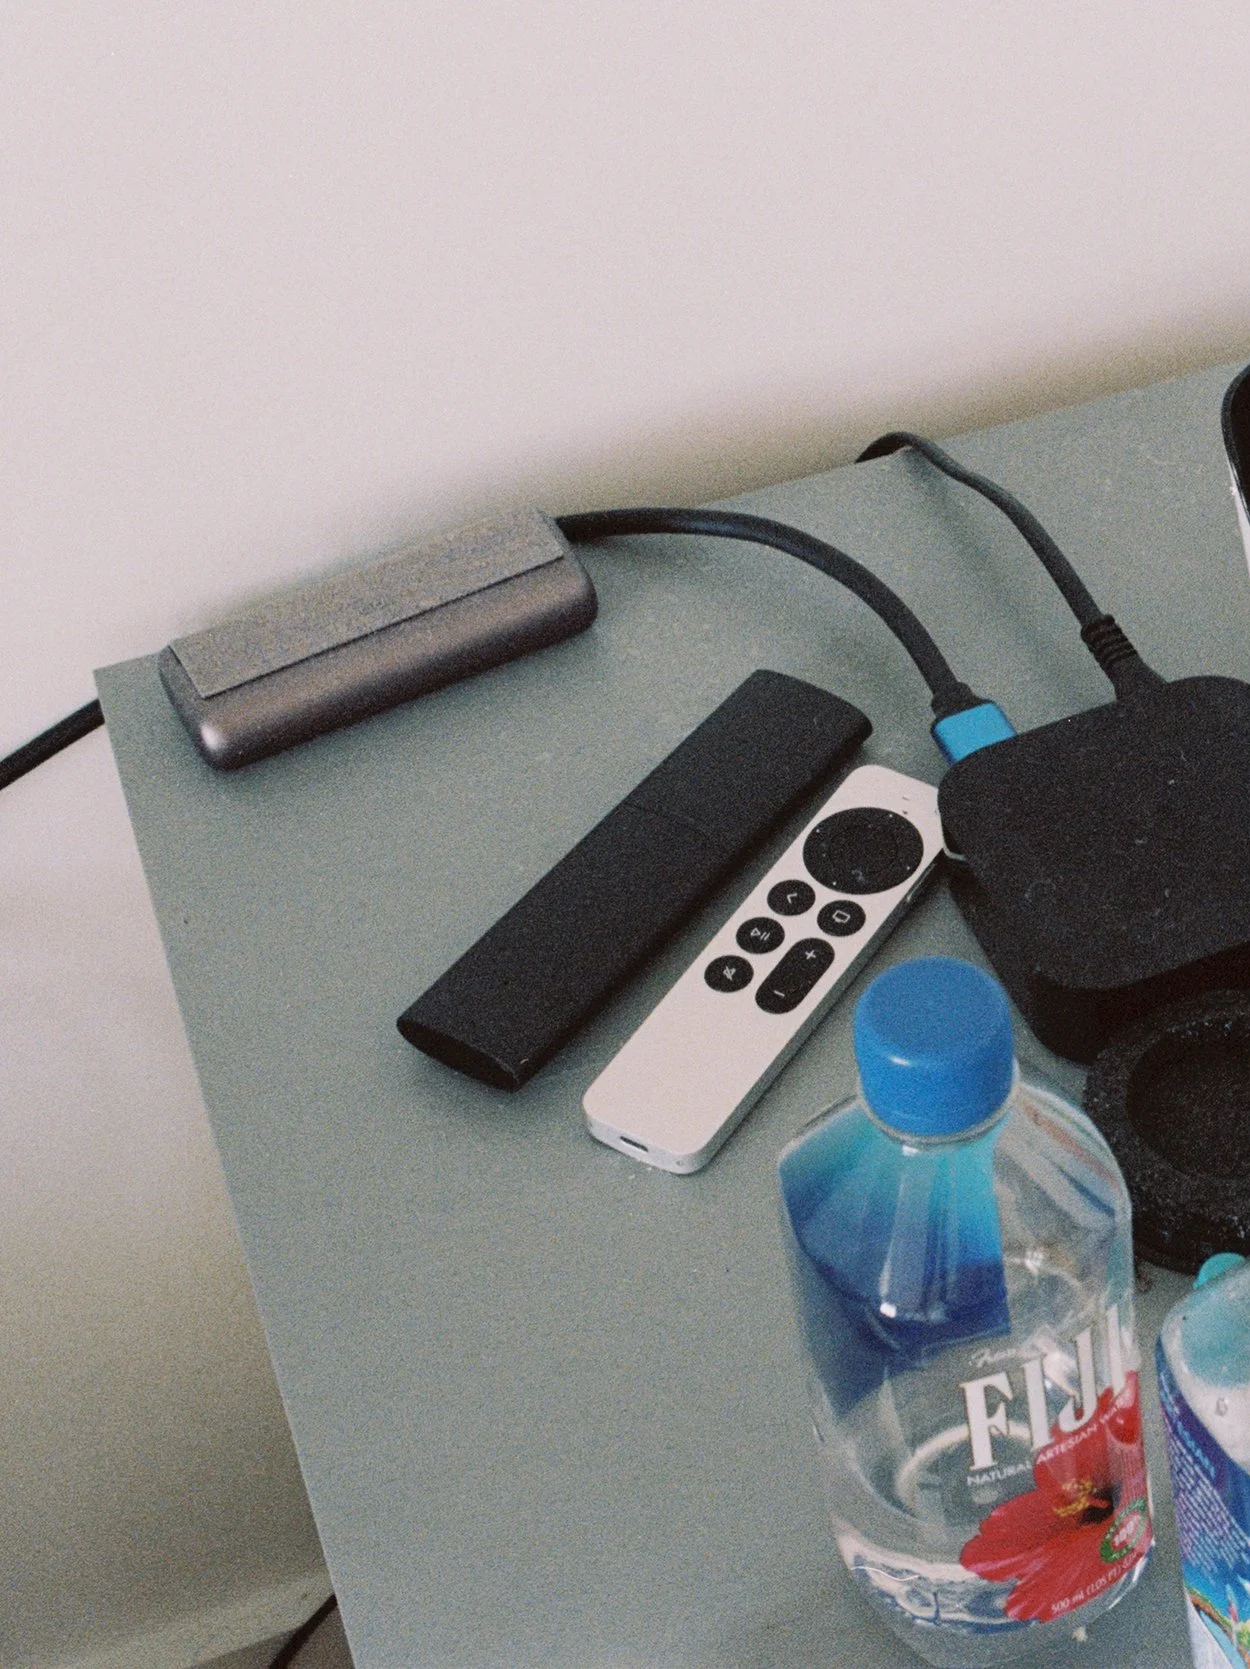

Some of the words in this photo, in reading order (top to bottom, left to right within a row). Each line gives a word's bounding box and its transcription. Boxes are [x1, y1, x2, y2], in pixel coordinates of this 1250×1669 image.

[958, 1303, 1126, 1472] FIJI
[966, 1460, 1033, 1486] NATURAL
[1036, 1423, 1099, 1465] ARTESIAN
